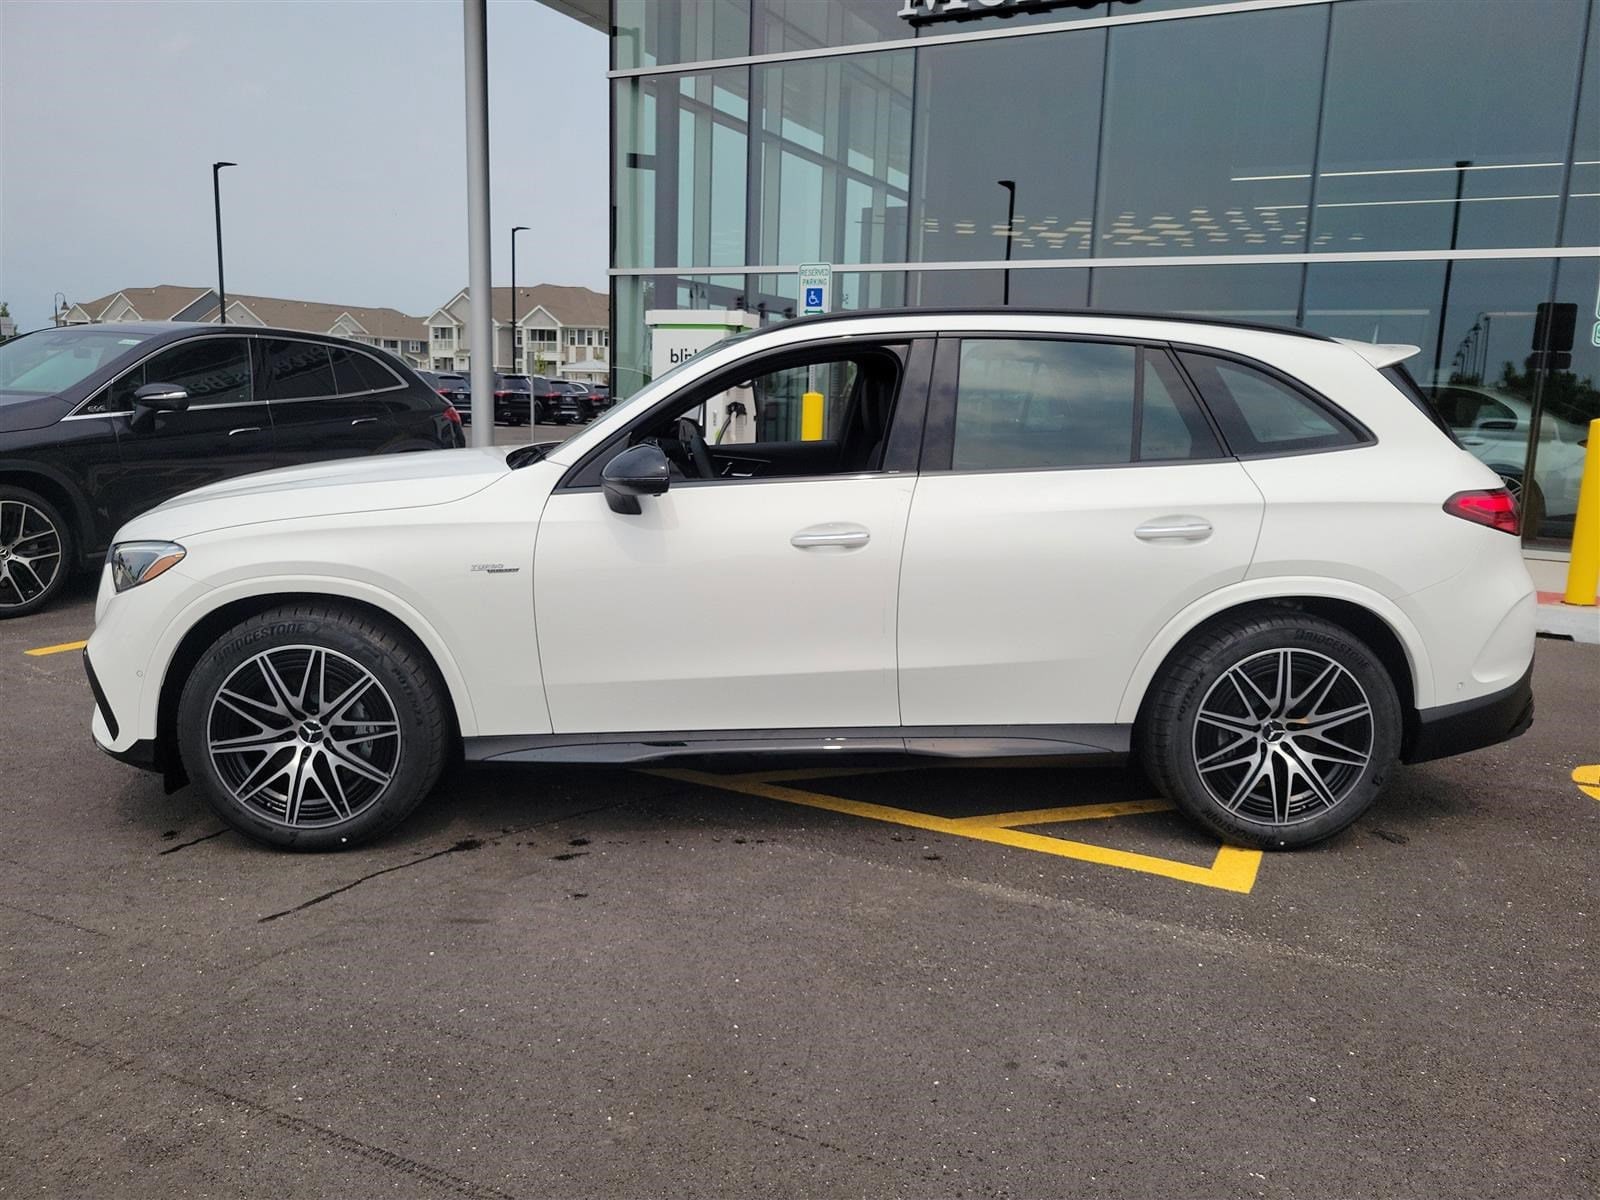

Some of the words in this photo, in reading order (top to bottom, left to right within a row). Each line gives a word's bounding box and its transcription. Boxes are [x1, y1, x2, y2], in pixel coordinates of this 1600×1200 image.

[800, 268, 829, 277] RESERVED
[802, 278, 828, 286] PARKING
[670, 348, 699, 363] bli
[213, 623, 305, 662] BRIDGESTONE
[1294, 628, 1370, 669] BRIDGESTONE
